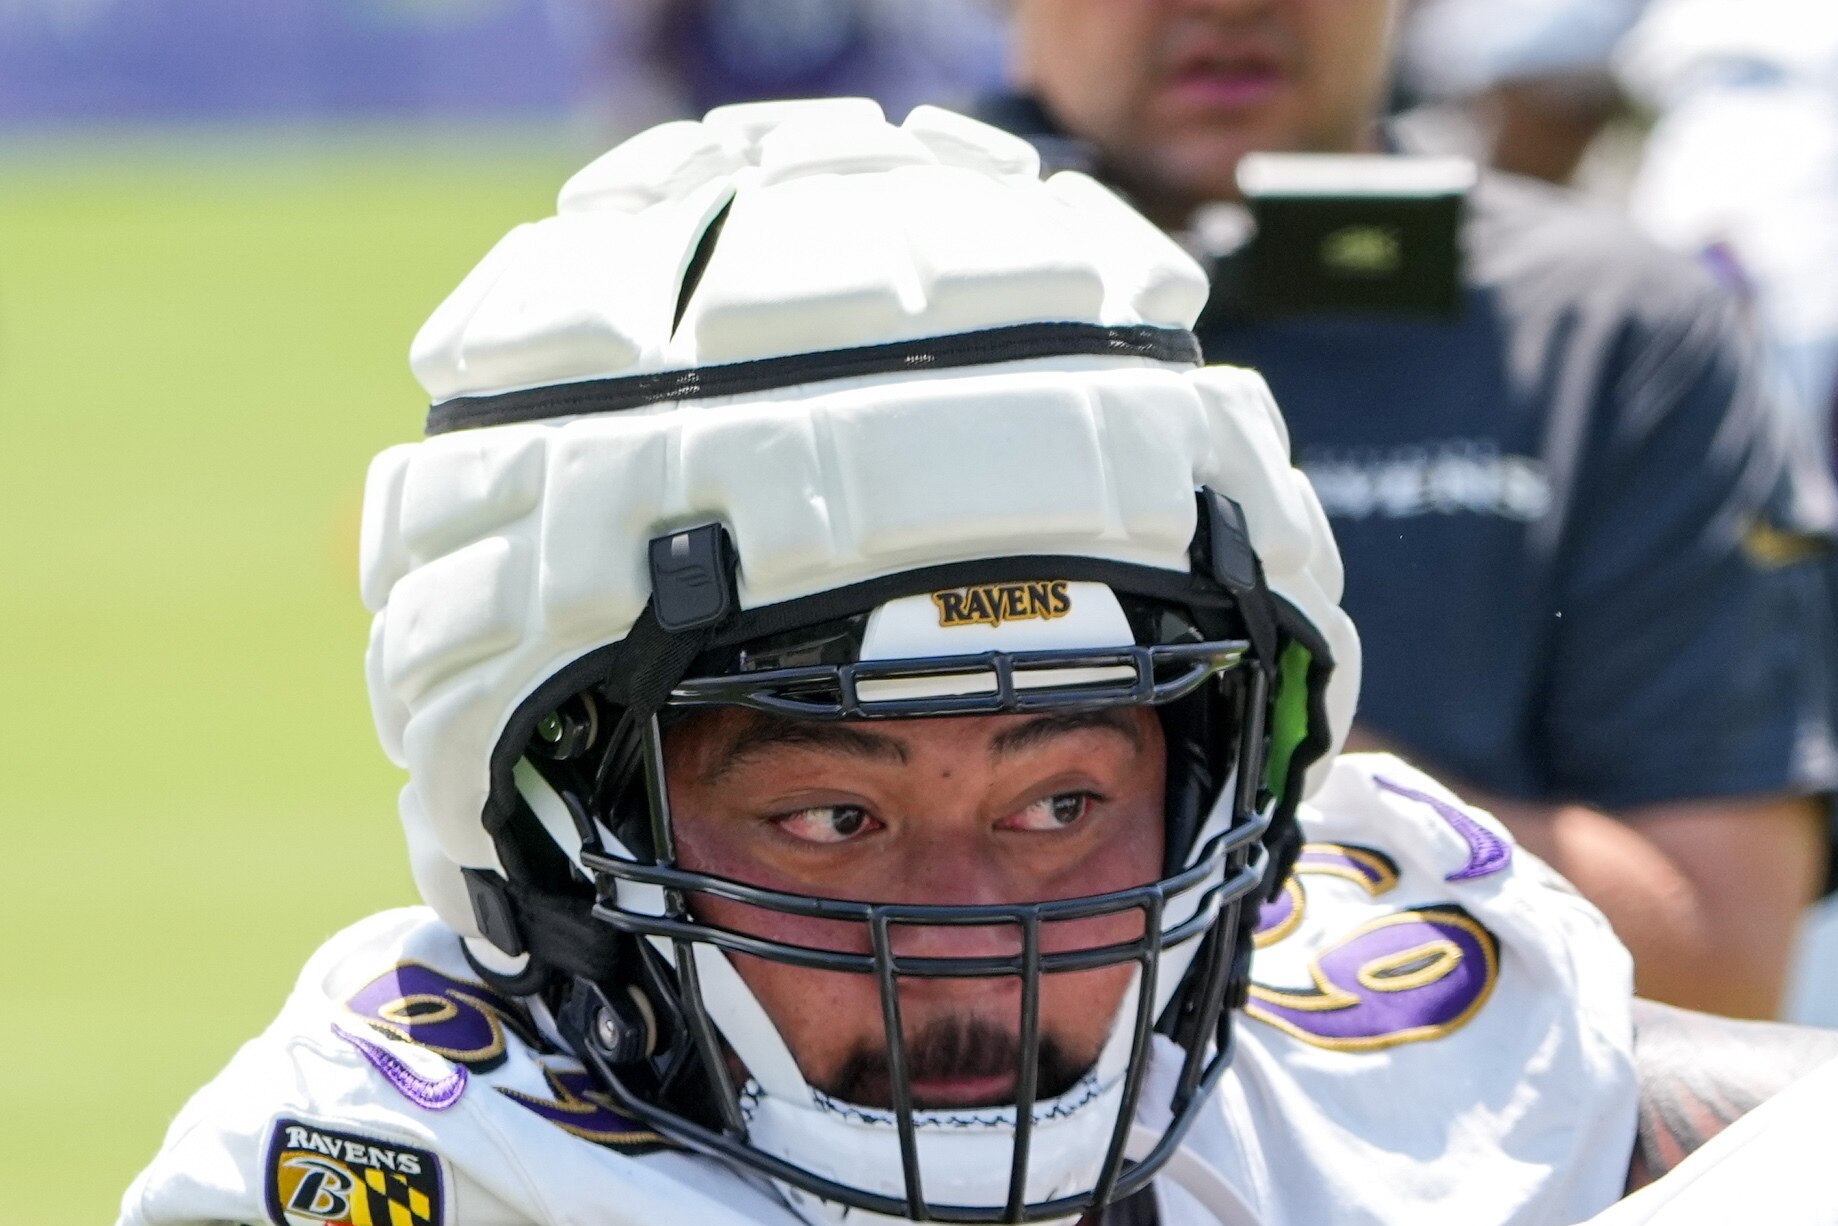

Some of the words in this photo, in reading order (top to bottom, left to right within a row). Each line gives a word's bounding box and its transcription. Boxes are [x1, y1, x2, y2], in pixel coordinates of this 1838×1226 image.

[932, 580, 1072, 627] RAVENS
[286, 1125, 421, 1174] RAVENS
[282, 1157, 356, 1219] B
